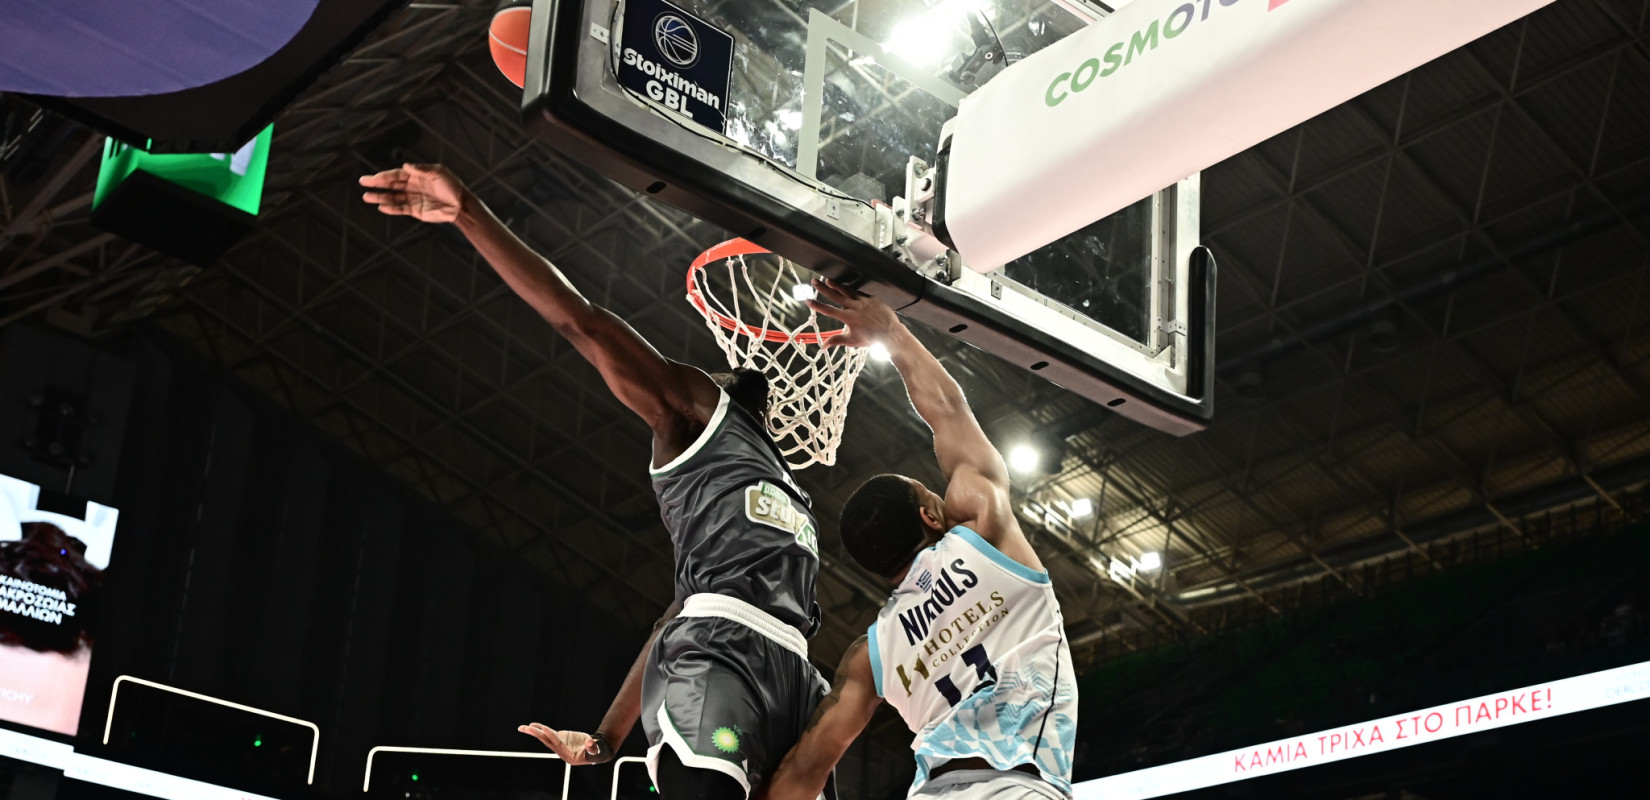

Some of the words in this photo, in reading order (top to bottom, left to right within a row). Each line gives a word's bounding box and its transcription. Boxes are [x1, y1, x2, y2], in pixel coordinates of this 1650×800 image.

[623, 47, 720, 110] Stoiximan
[1044, 0, 1240, 107] COSMOT
[646, 80, 694, 119] GBL
[923, 590, 1005, 657] HOTELS
[1234, 741, 1308, 773] ΚΑΜΙΑ
[1318, 725, 1384, 755] ΤΡΙΧΑ
[1395, 712, 1444, 740] ΣΤΟ
[1455, 688, 1552, 727] ΠΑΡΚΕ!
